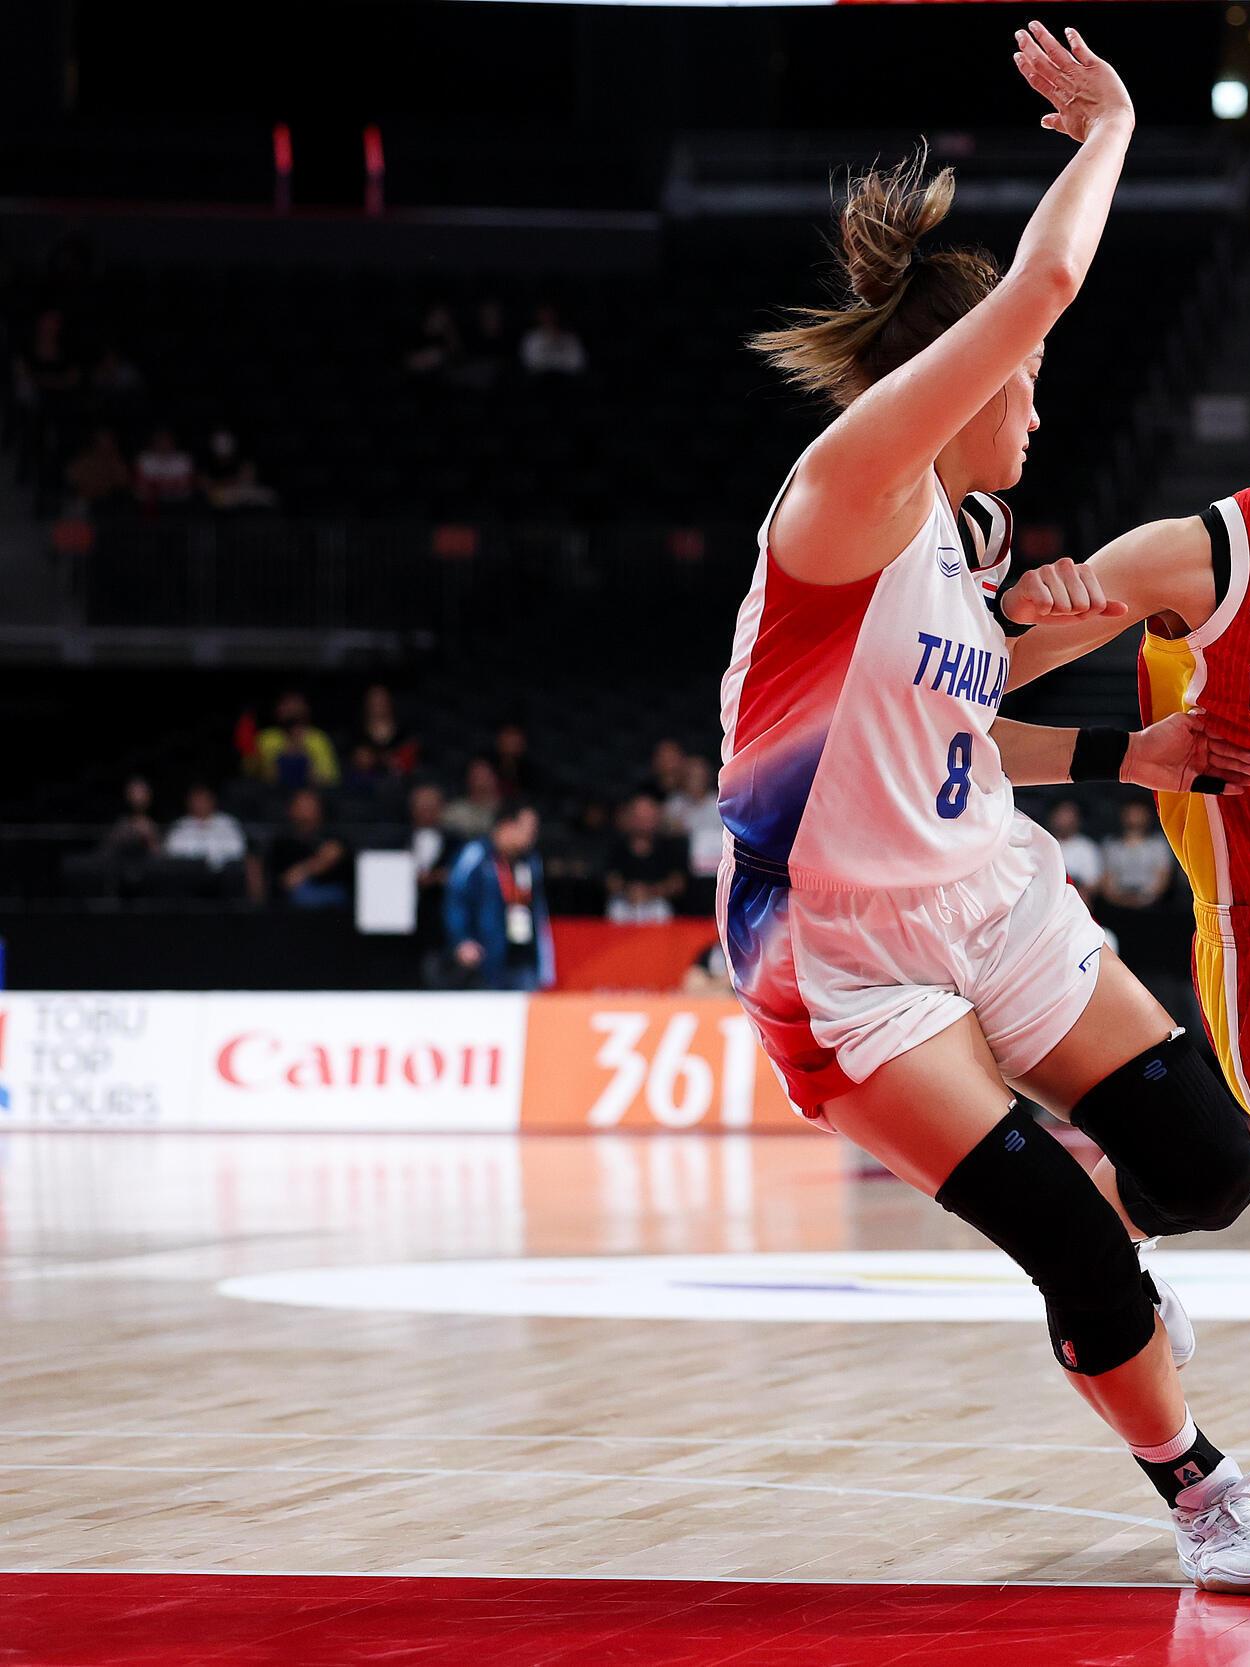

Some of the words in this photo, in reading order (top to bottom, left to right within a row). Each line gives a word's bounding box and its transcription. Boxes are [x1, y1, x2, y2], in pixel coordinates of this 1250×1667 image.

[936, 732, 973, 819] 8
[32, 1042, 112, 1077] TOP
[215, 1029, 504, 1089] Canon
[588, 1011, 757, 1126] 361
